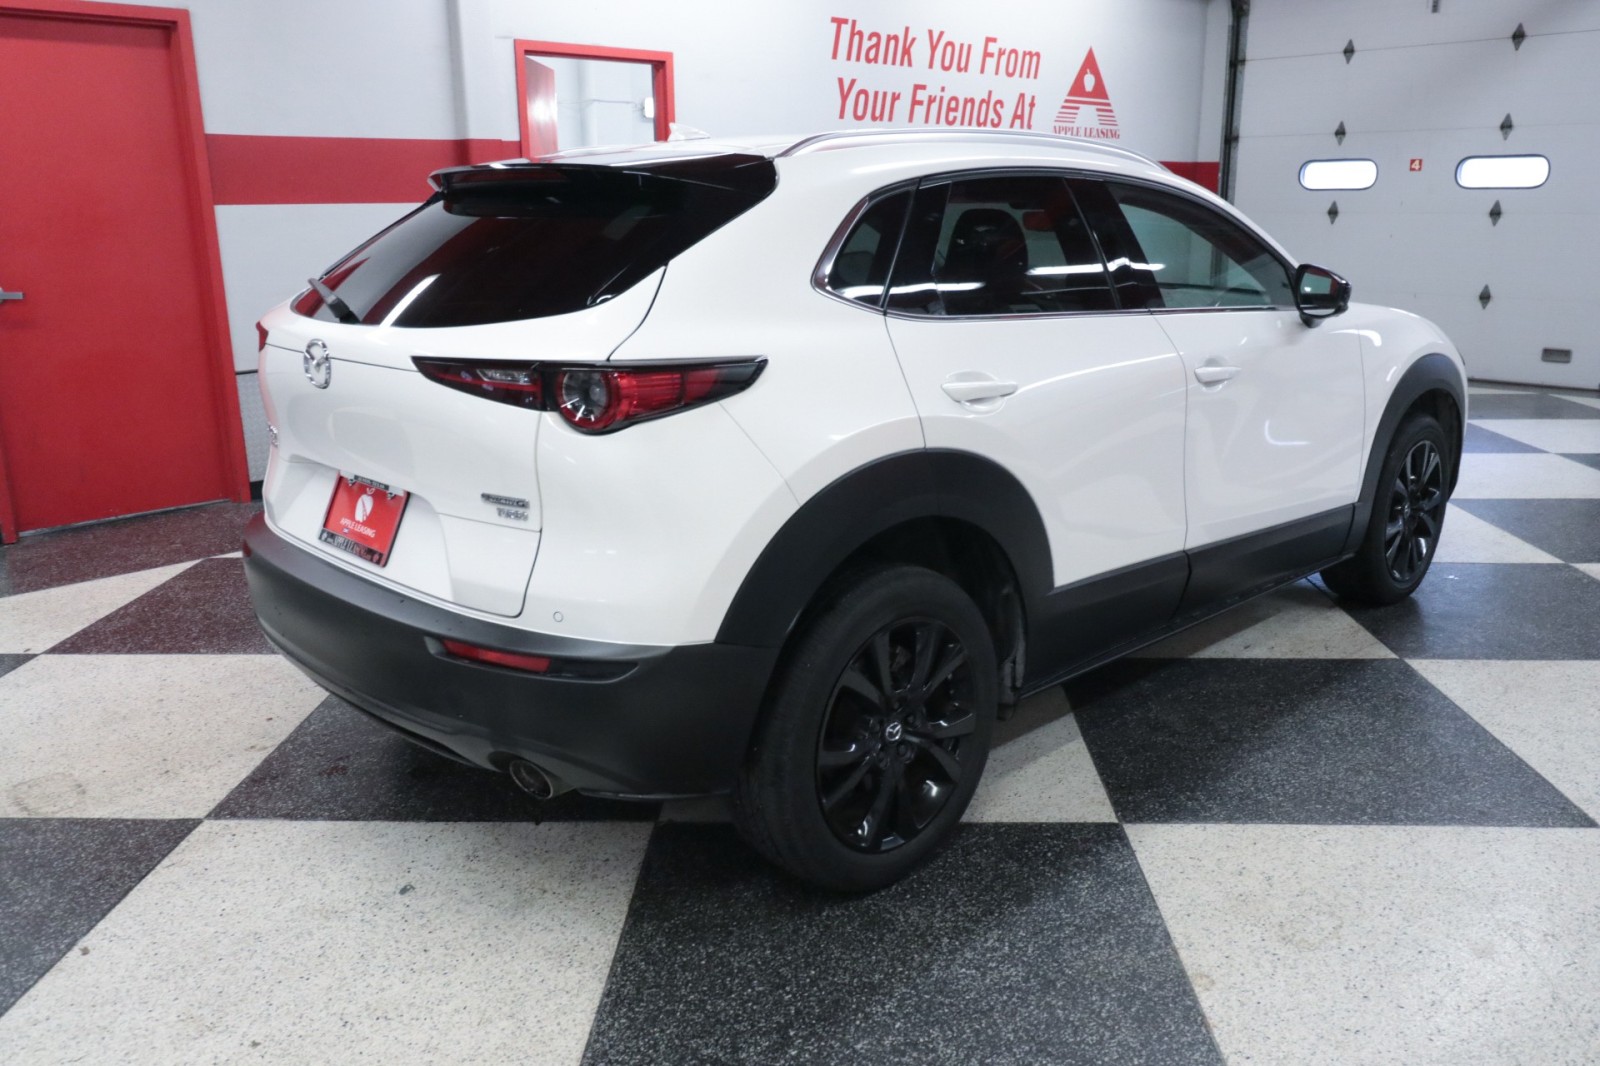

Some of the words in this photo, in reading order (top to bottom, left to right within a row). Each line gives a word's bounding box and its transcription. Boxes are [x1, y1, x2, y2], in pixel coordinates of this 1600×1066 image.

[830, 16, 917, 68] Thank
[927, 29, 973, 74] You
[979, 36, 1041, 79] From
[837, 77, 901, 122] Your
[908, 83, 1005, 129] Friends
[1010, 92, 1036, 130] At
[1052, 125, 1082, 137] APPLE
[1083, 127, 1120, 139] LEASING
[1411, 159, 1421, 171] 4
[340, 517, 356, 531] APPLE
[354, 522, 377, 538] LEASING
